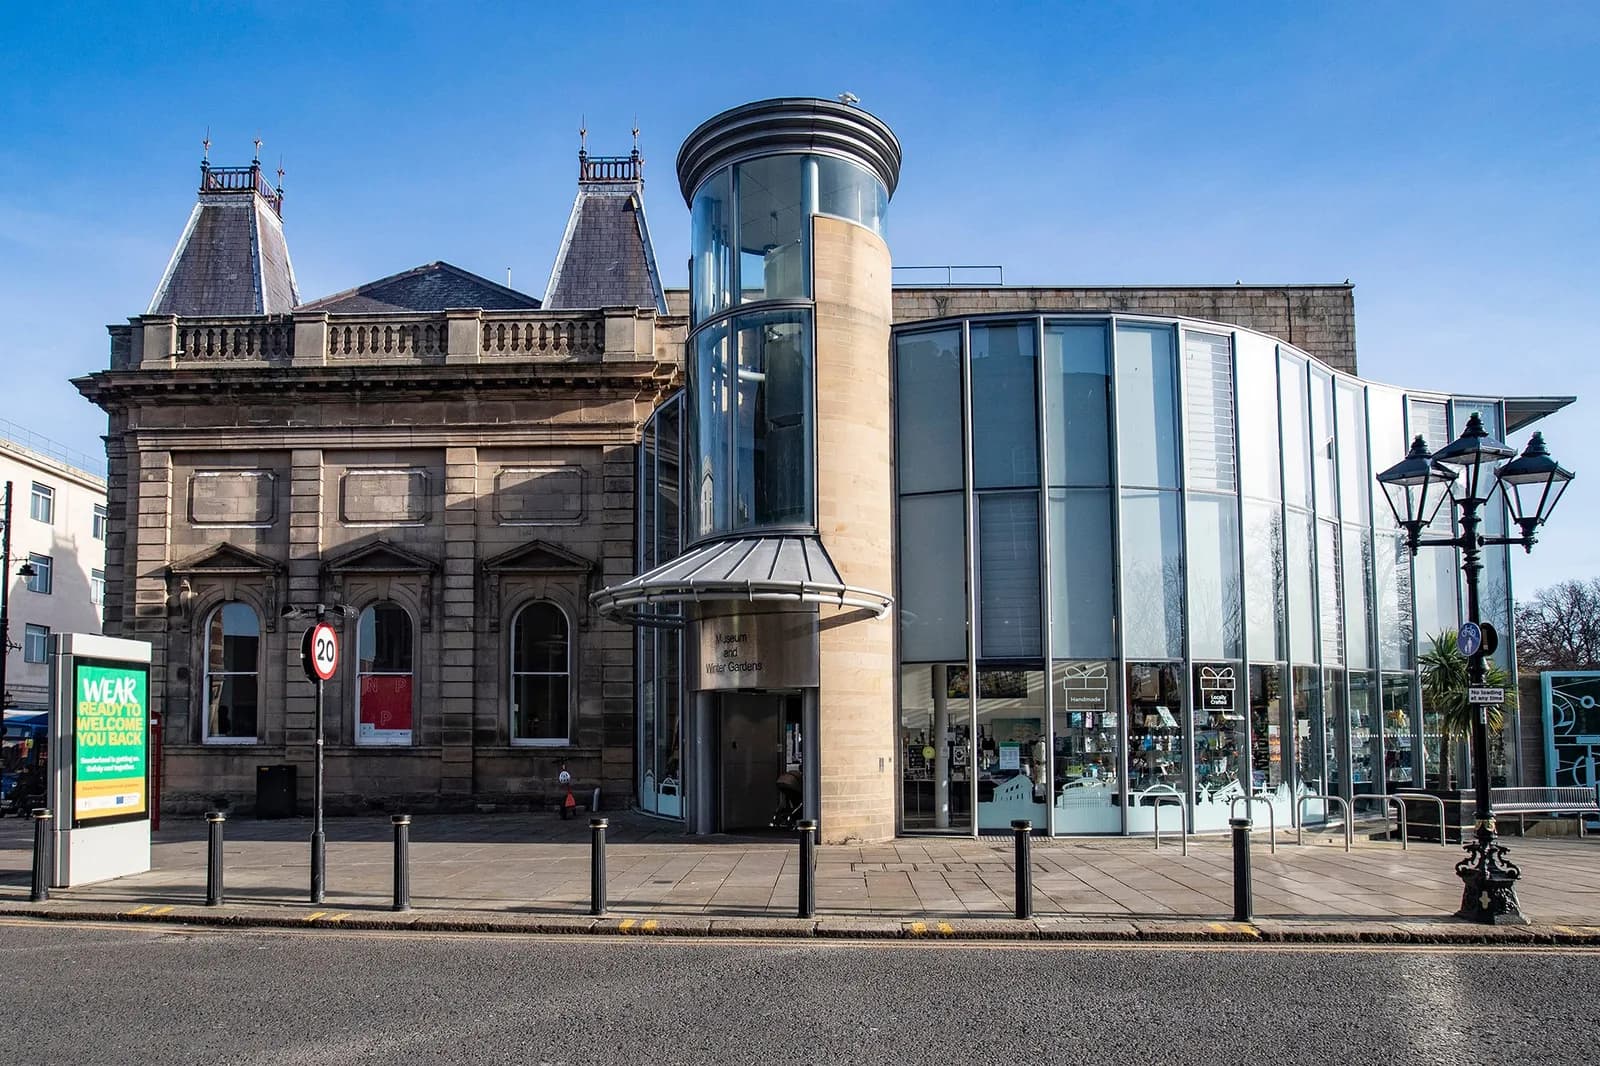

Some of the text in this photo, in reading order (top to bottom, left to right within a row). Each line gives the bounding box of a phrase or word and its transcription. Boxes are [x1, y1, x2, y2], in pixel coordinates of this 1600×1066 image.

[715, 633, 747, 644] Museum
[317, 638, 334, 663] 20
[723, 648, 738, 658] and
[706, 661, 763, 674] Winter Gardens
[83, 676, 138, 705] WEAR
[80, 701, 141, 717] READY TO
[77, 716, 143, 731] WELCOME
[77, 731, 142, 746] YOU BACK
